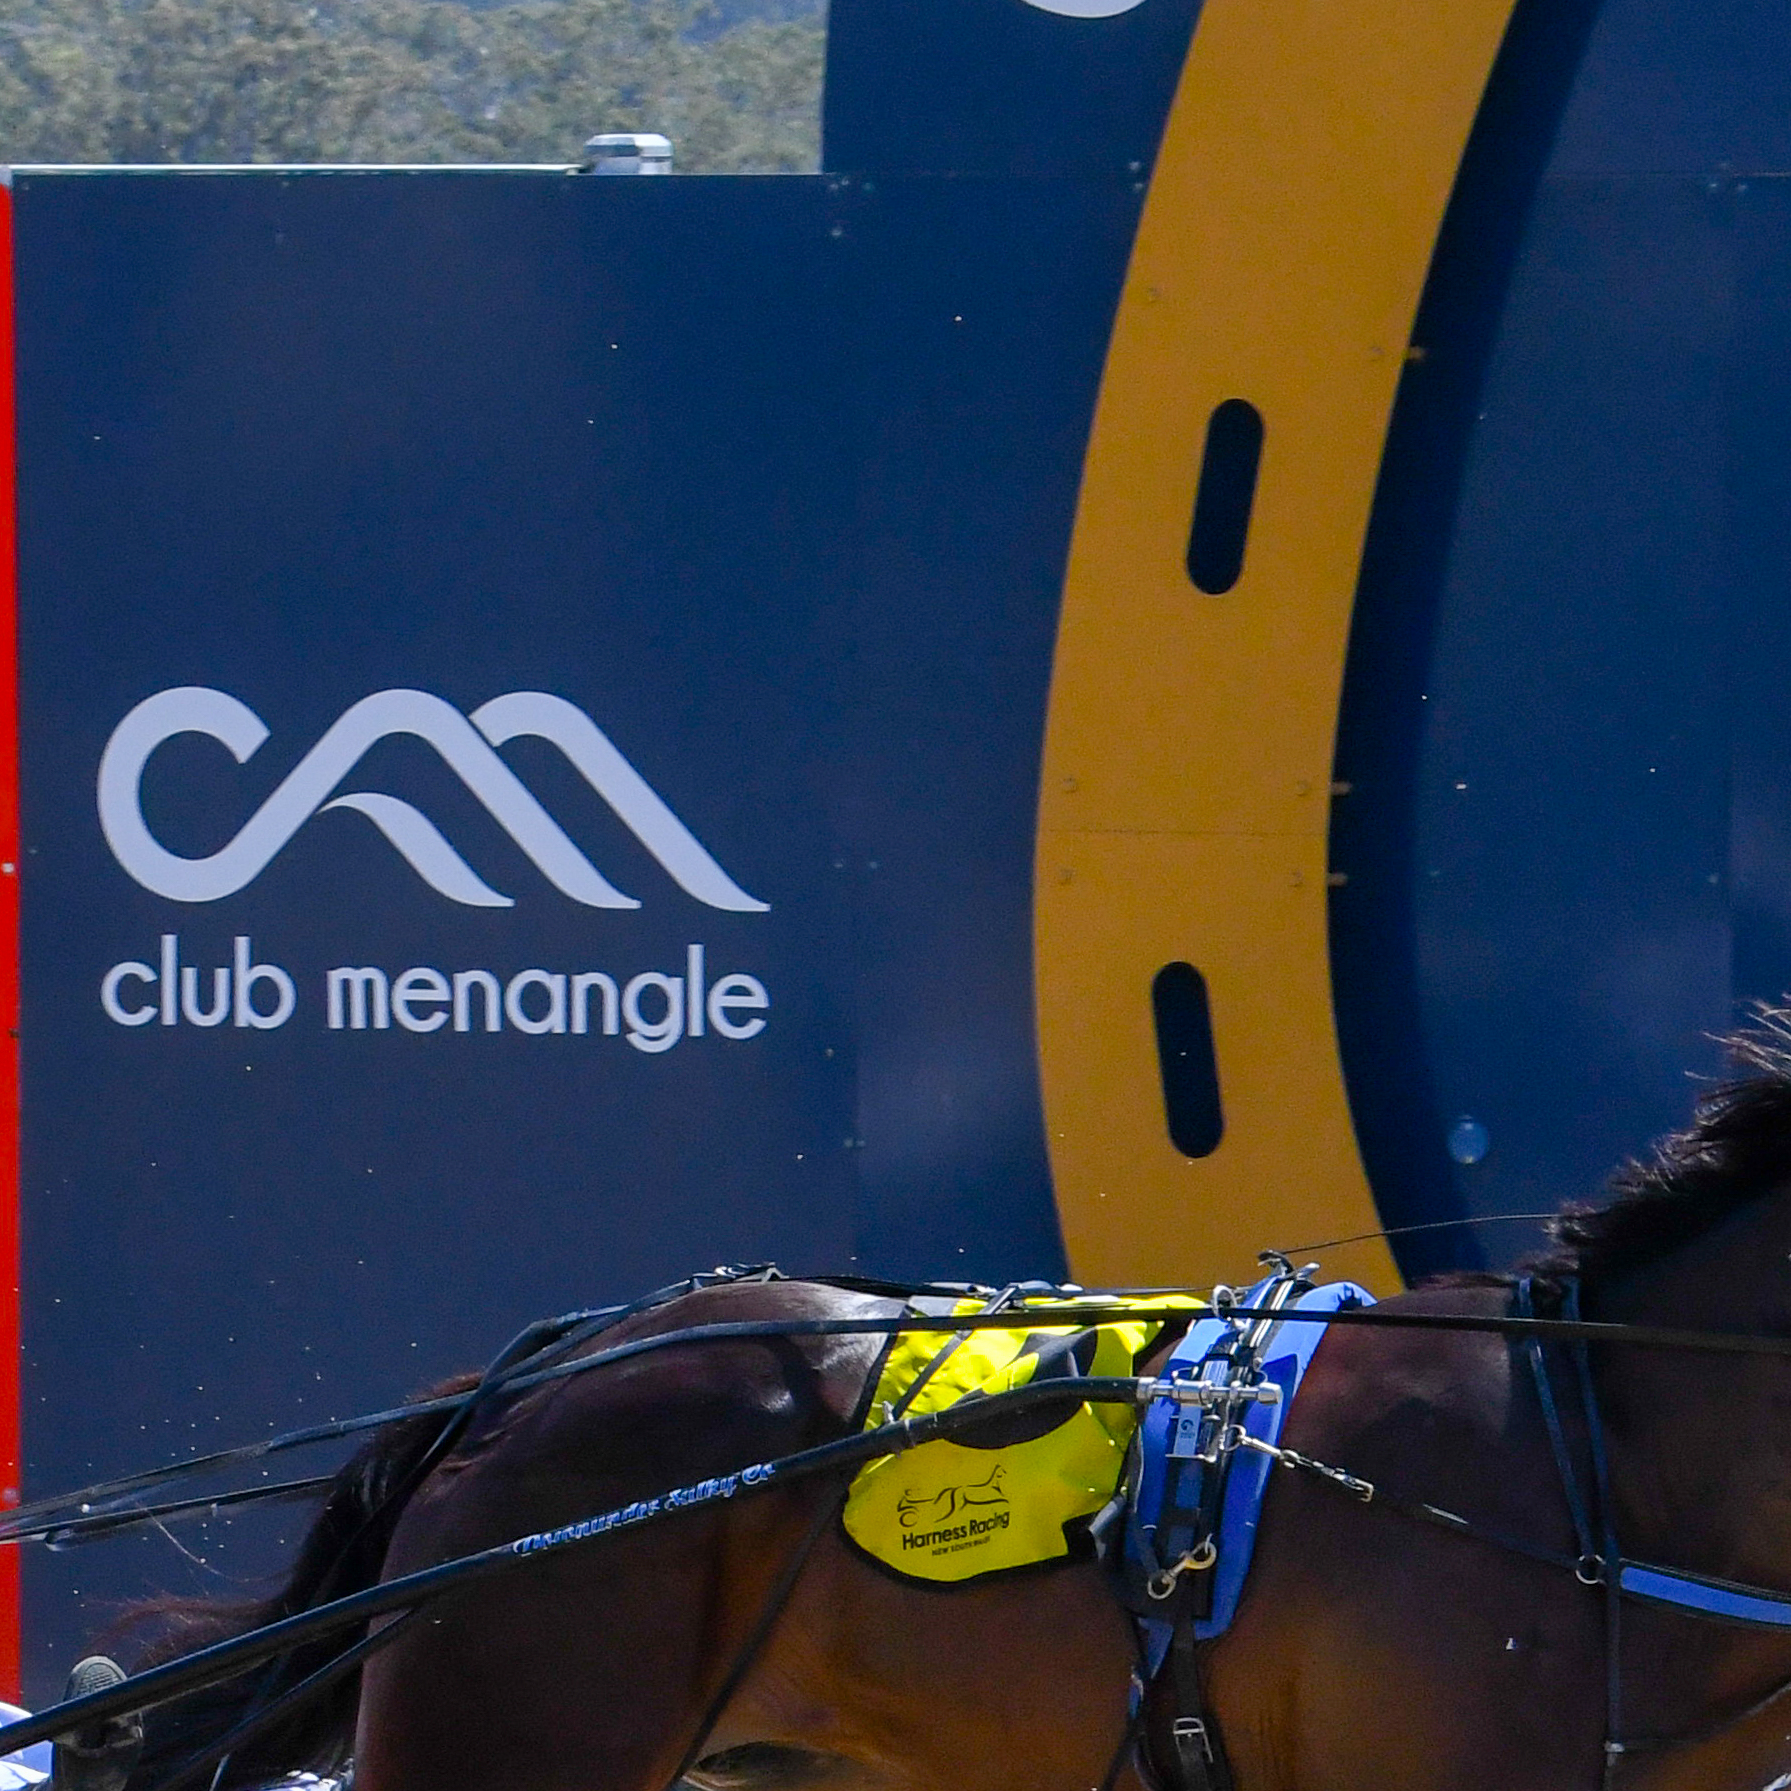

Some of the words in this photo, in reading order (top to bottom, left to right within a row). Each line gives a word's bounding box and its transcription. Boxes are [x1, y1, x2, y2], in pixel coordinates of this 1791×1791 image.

[100, 934, 296, 1029] club
[326, 944, 770, 1053] menangle
[902, 1524, 967, 1551] Harness
